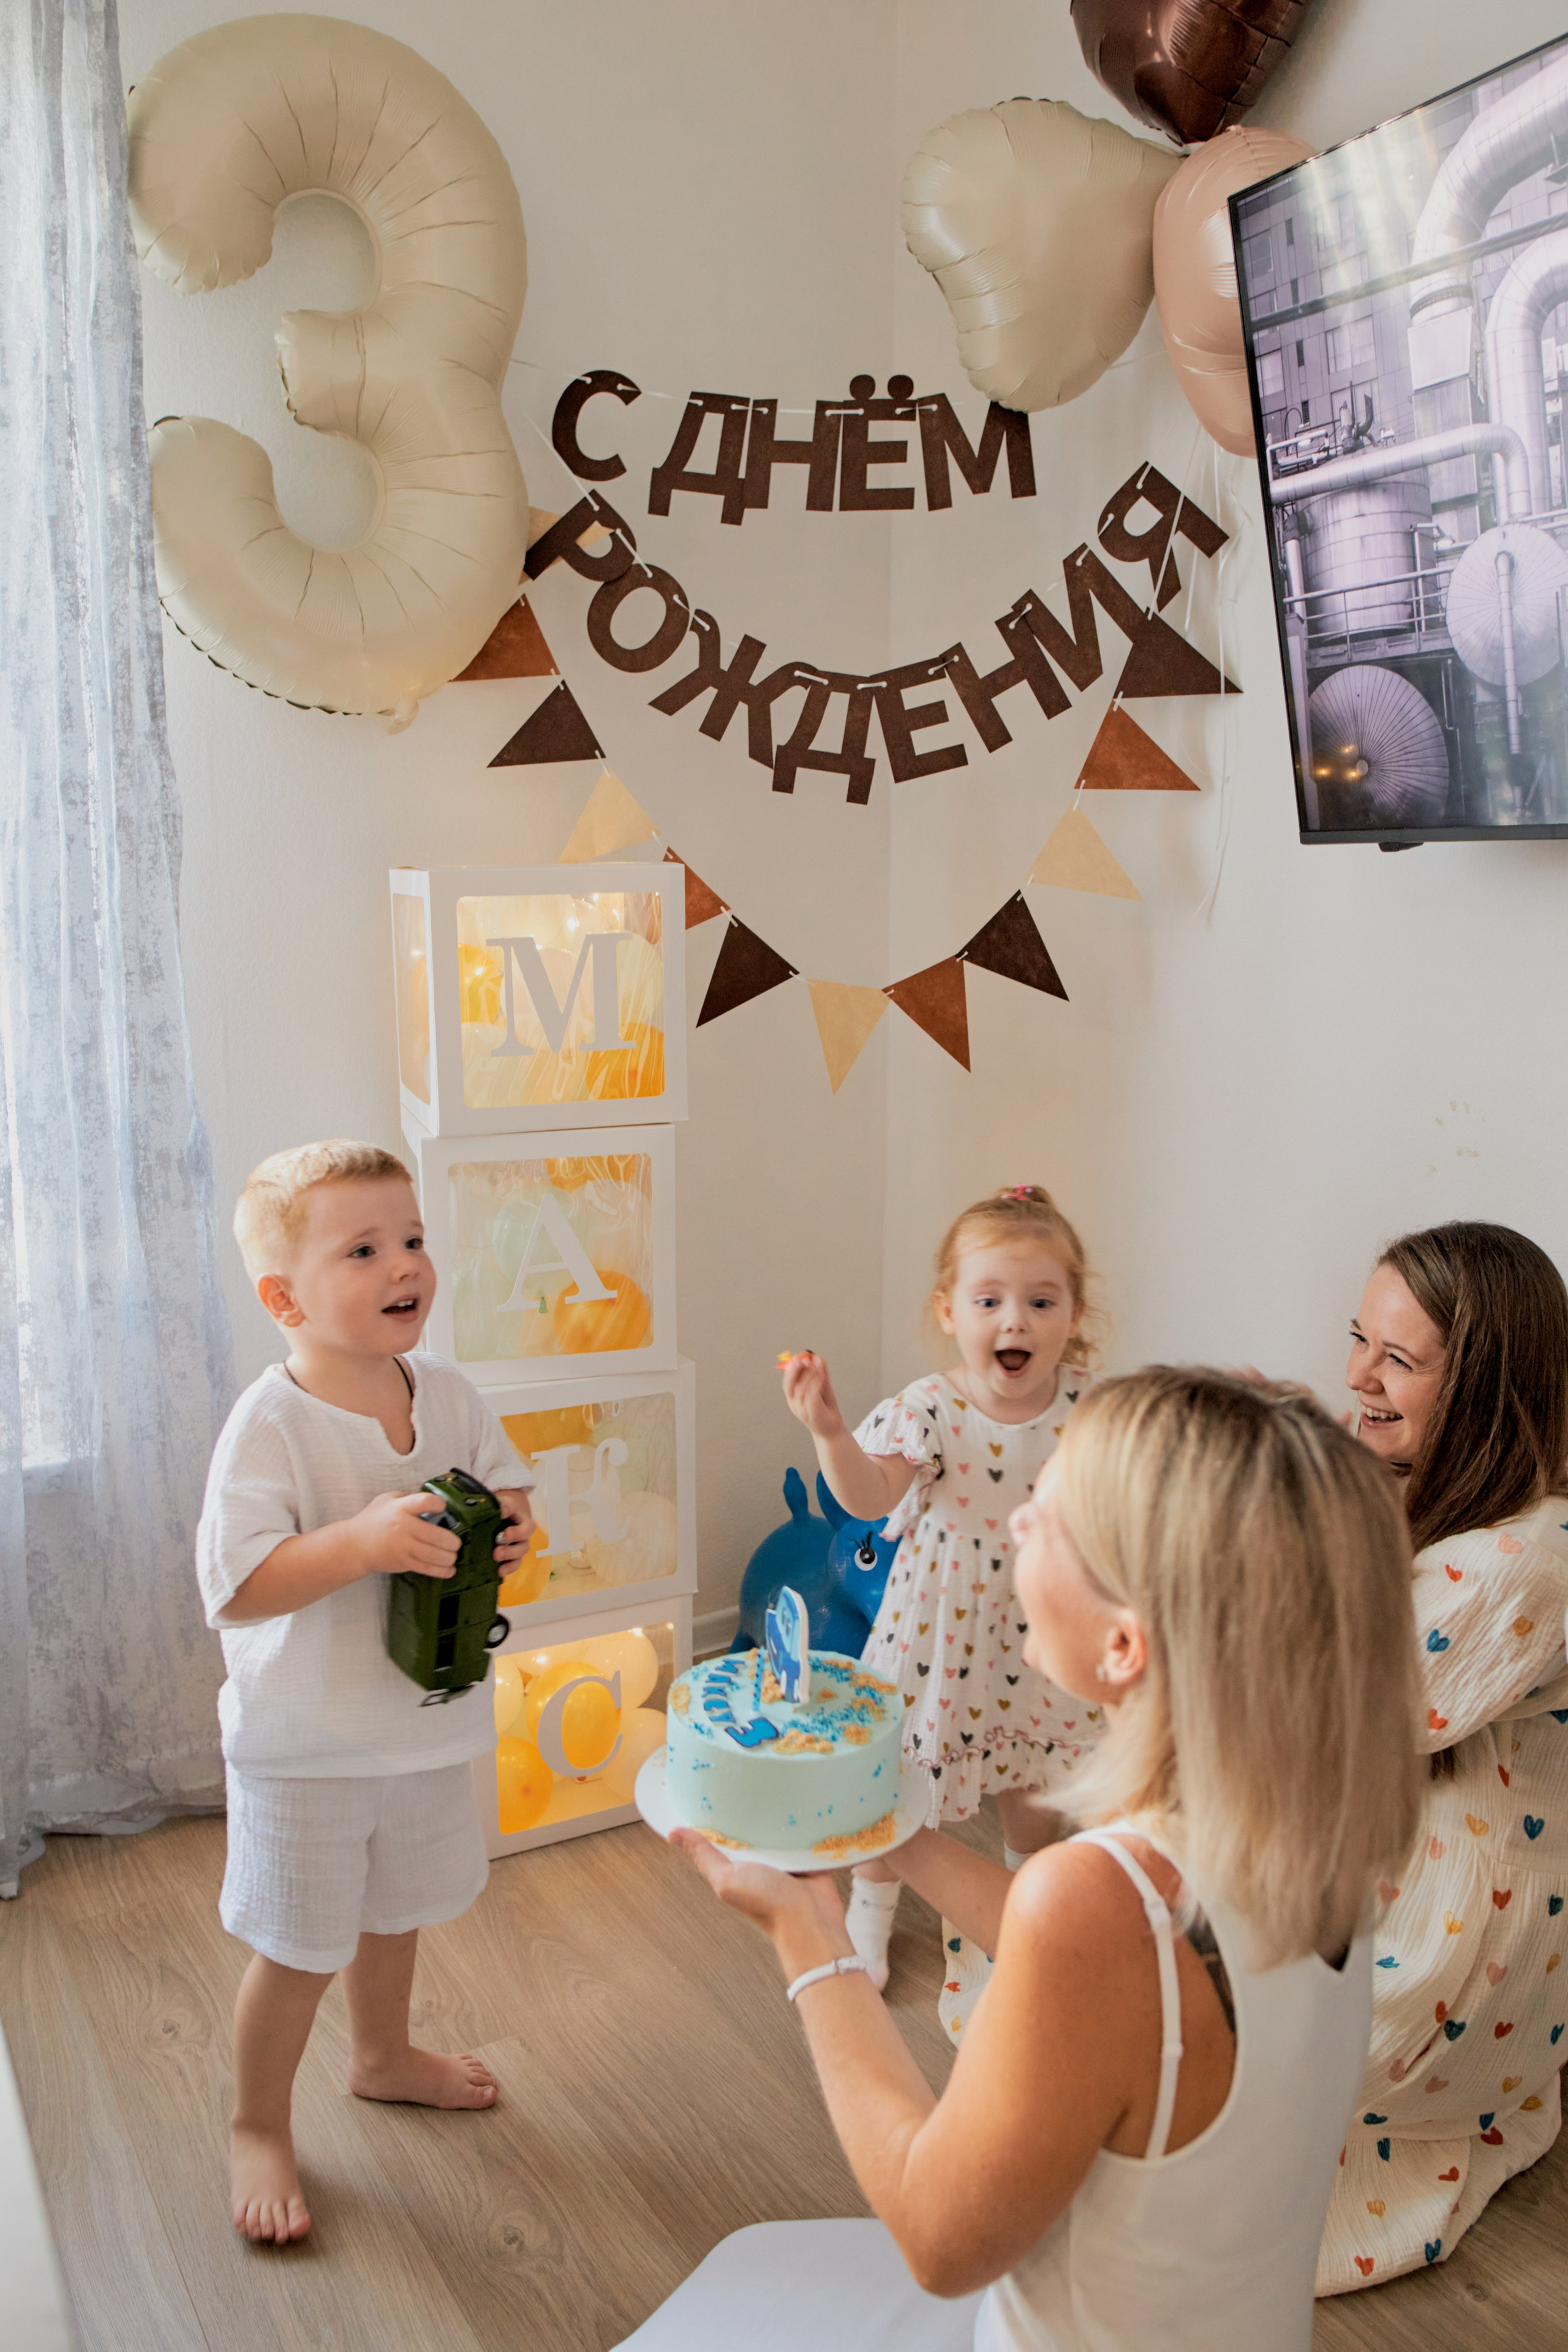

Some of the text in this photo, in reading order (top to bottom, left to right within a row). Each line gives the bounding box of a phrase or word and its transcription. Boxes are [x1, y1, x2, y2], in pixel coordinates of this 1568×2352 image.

[127, 12, 529, 718] 3
[551, 370, 1036, 526] С ДНЁМ
[523, 461, 1230, 805] РОЖДЕНИЯ
